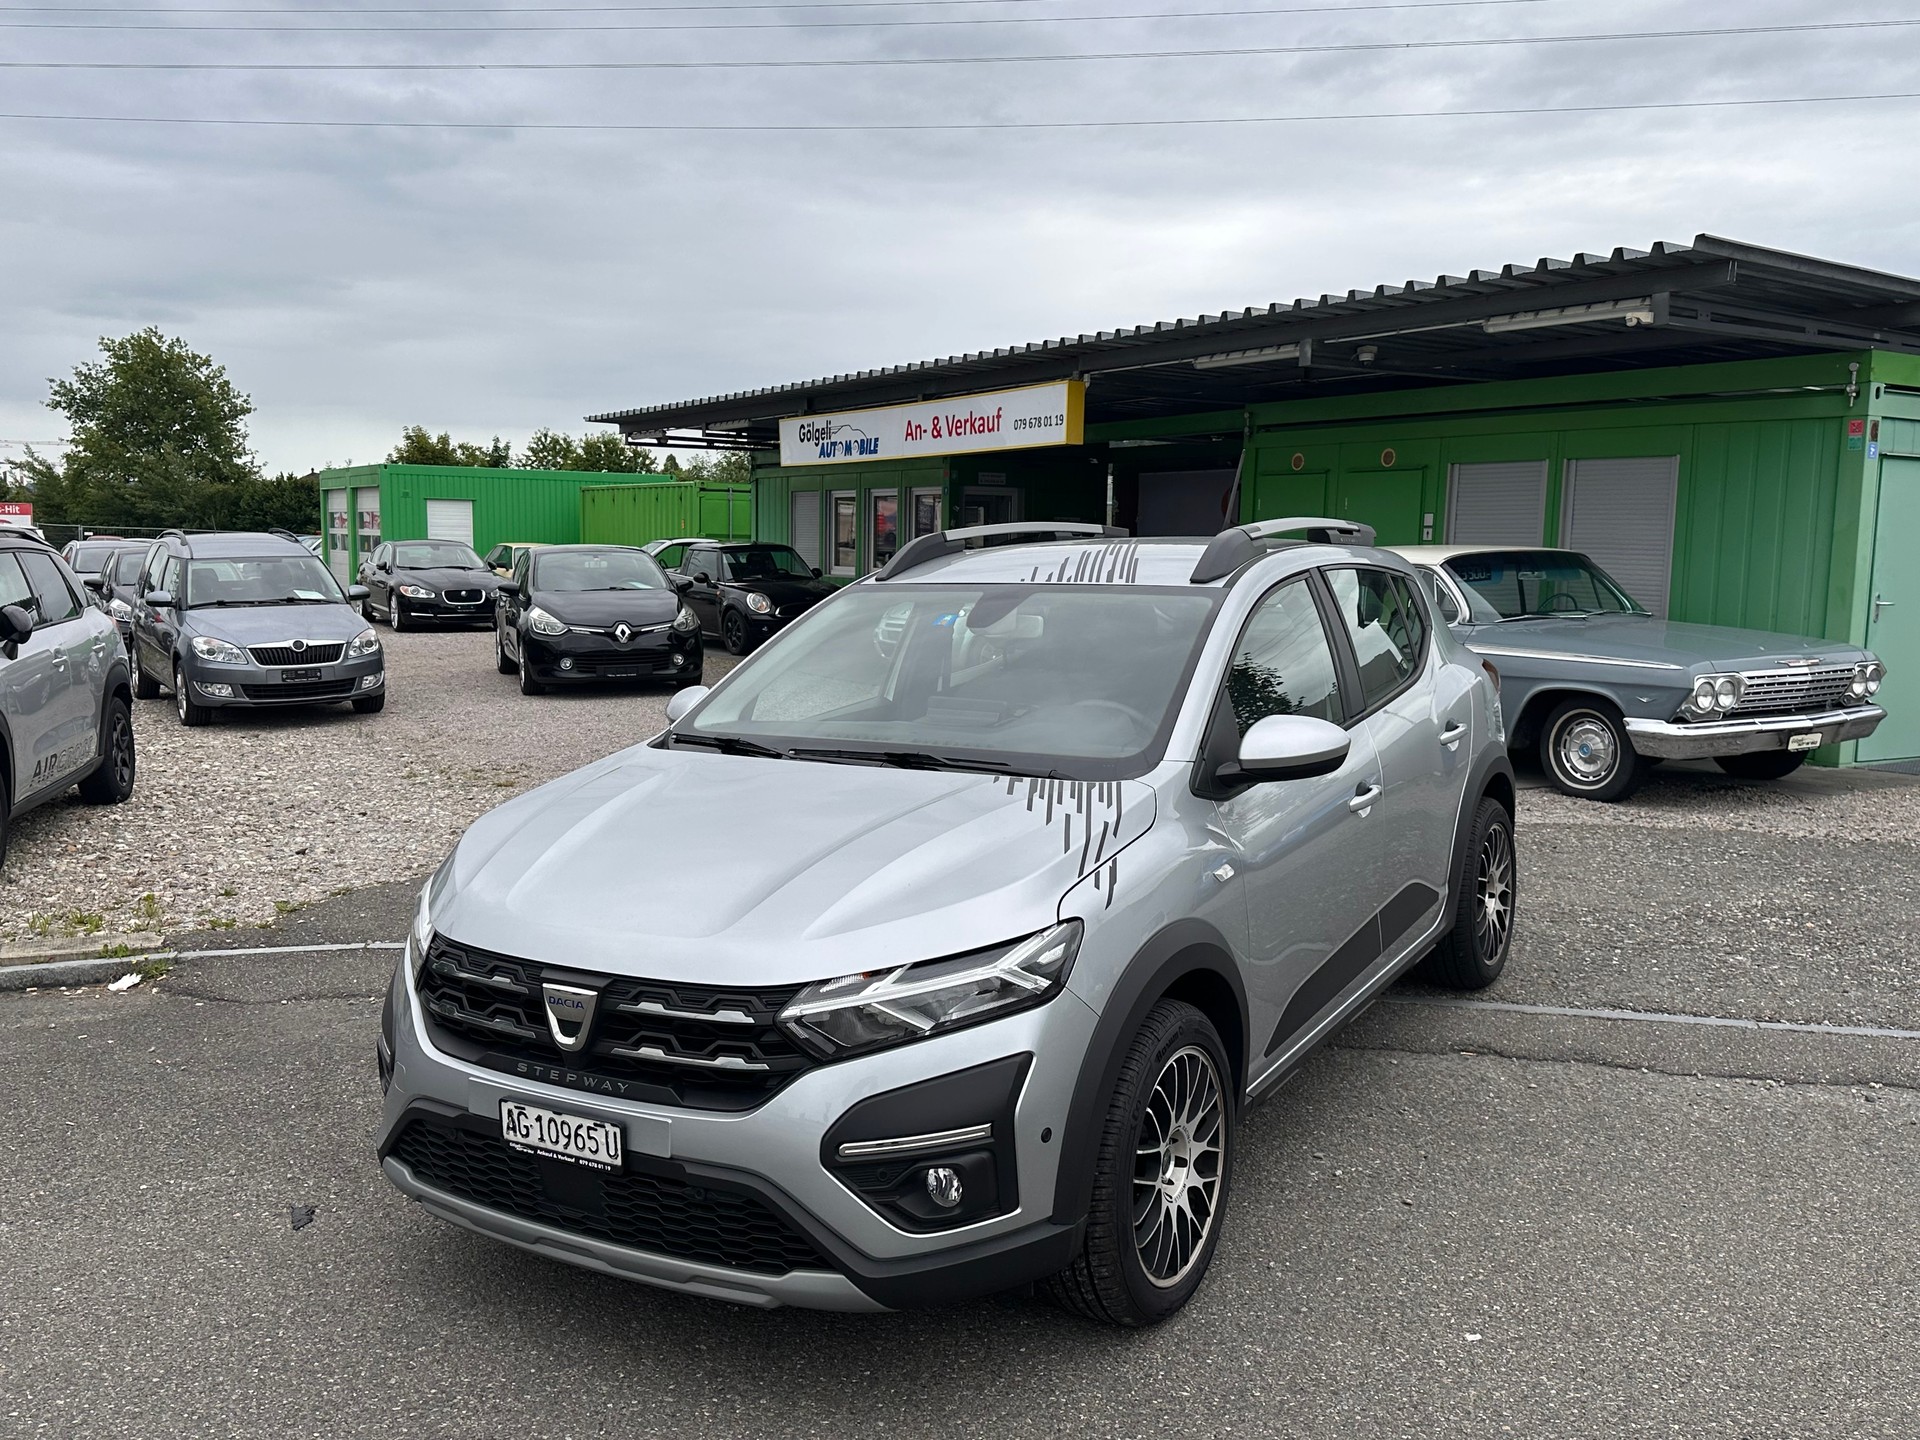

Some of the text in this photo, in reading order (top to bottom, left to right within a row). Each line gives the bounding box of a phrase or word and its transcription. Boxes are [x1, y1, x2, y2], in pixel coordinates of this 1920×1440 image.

[798, 419, 832, 447] Gölgeli
[905, 407, 1003, 442] An- & Verkauf
[1013, 414, 1064, 431] 079 678 01 19
[0, 504, 20, 514] -Hit
[548, 995, 585, 1010] DACIA
[516, 1062, 630, 1093] STEPWAY
